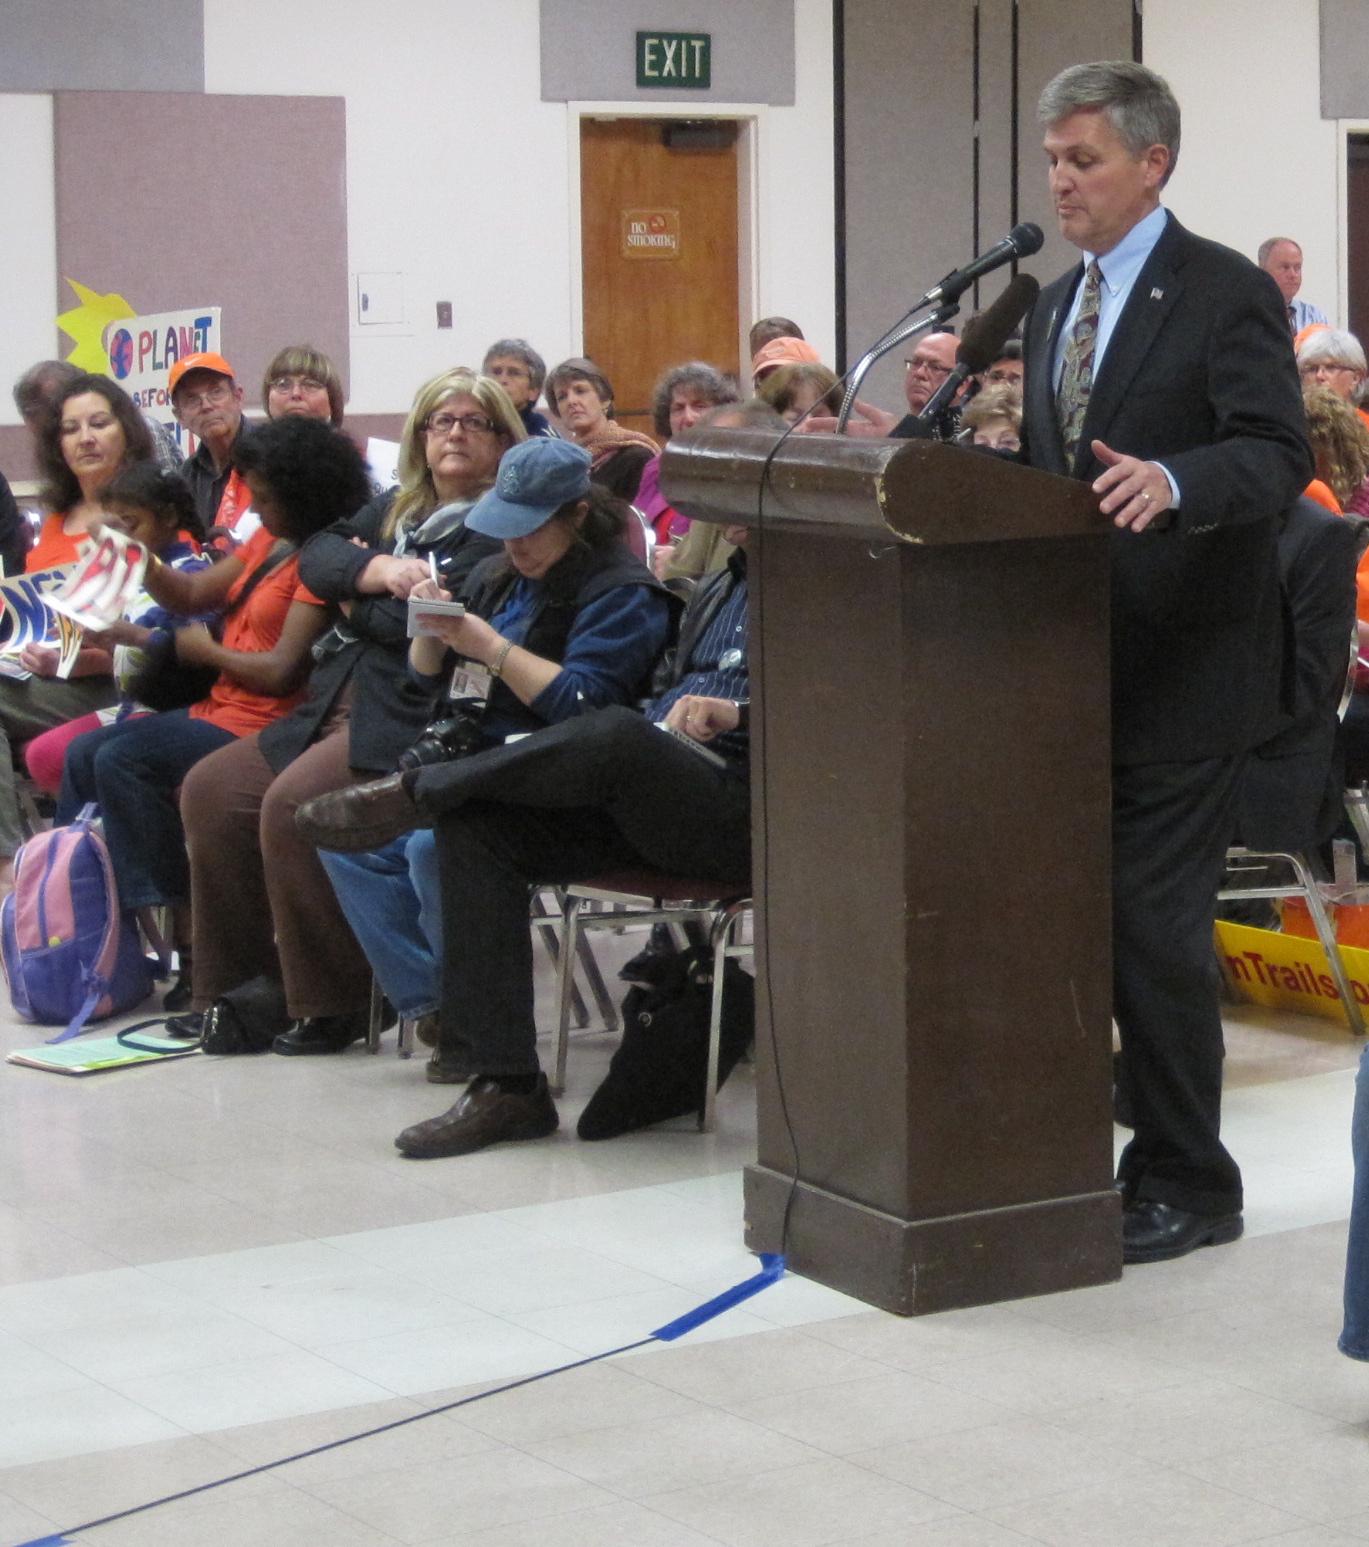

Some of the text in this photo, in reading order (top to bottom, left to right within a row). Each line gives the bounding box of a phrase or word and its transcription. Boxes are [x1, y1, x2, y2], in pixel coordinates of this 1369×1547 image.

[644, 38, 706, 78] EXIT
[631, 222, 647, 234] NO
[627, 234, 676, 249] SMOKING
[138, 316, 213, 374] PLANET
[133, 387, 172, 409] BEFOR
